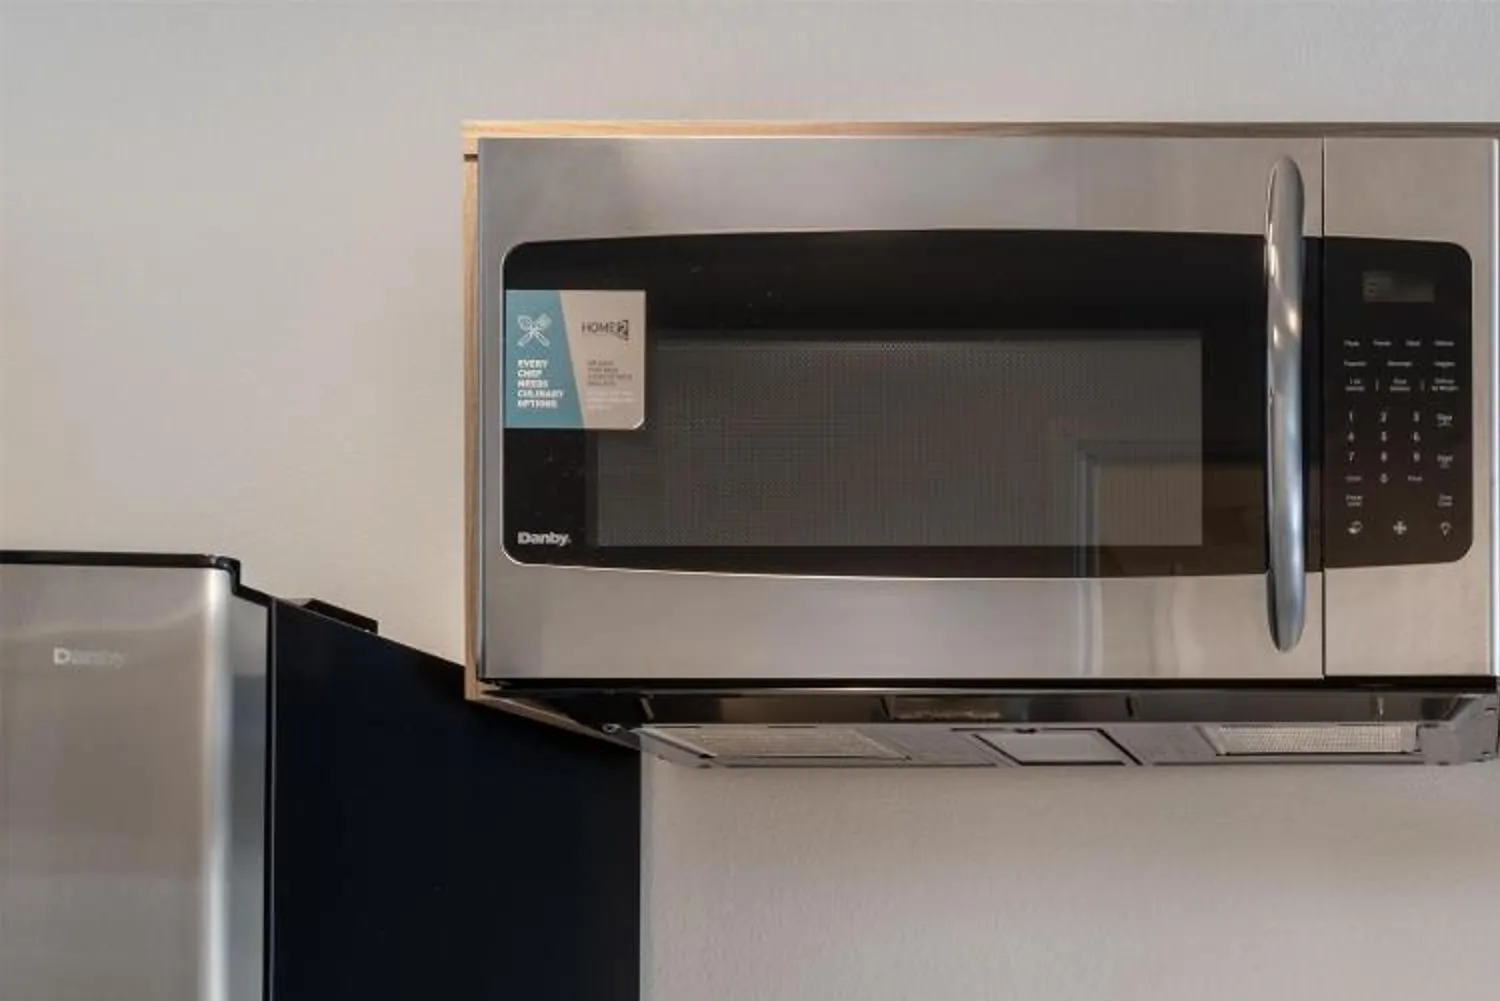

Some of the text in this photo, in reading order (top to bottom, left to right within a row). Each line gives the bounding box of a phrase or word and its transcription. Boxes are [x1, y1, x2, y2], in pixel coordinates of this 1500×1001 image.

[517, 359, 548, 369] EVERY
[517, 369, 542, 378] CHEF
[517, 379, 549, 388] NEEDS
[517, 389, 564, 399] CULINARY
[517, 399, 558, 409] OPTIONS
[517, 531, 570, 547] Danby
